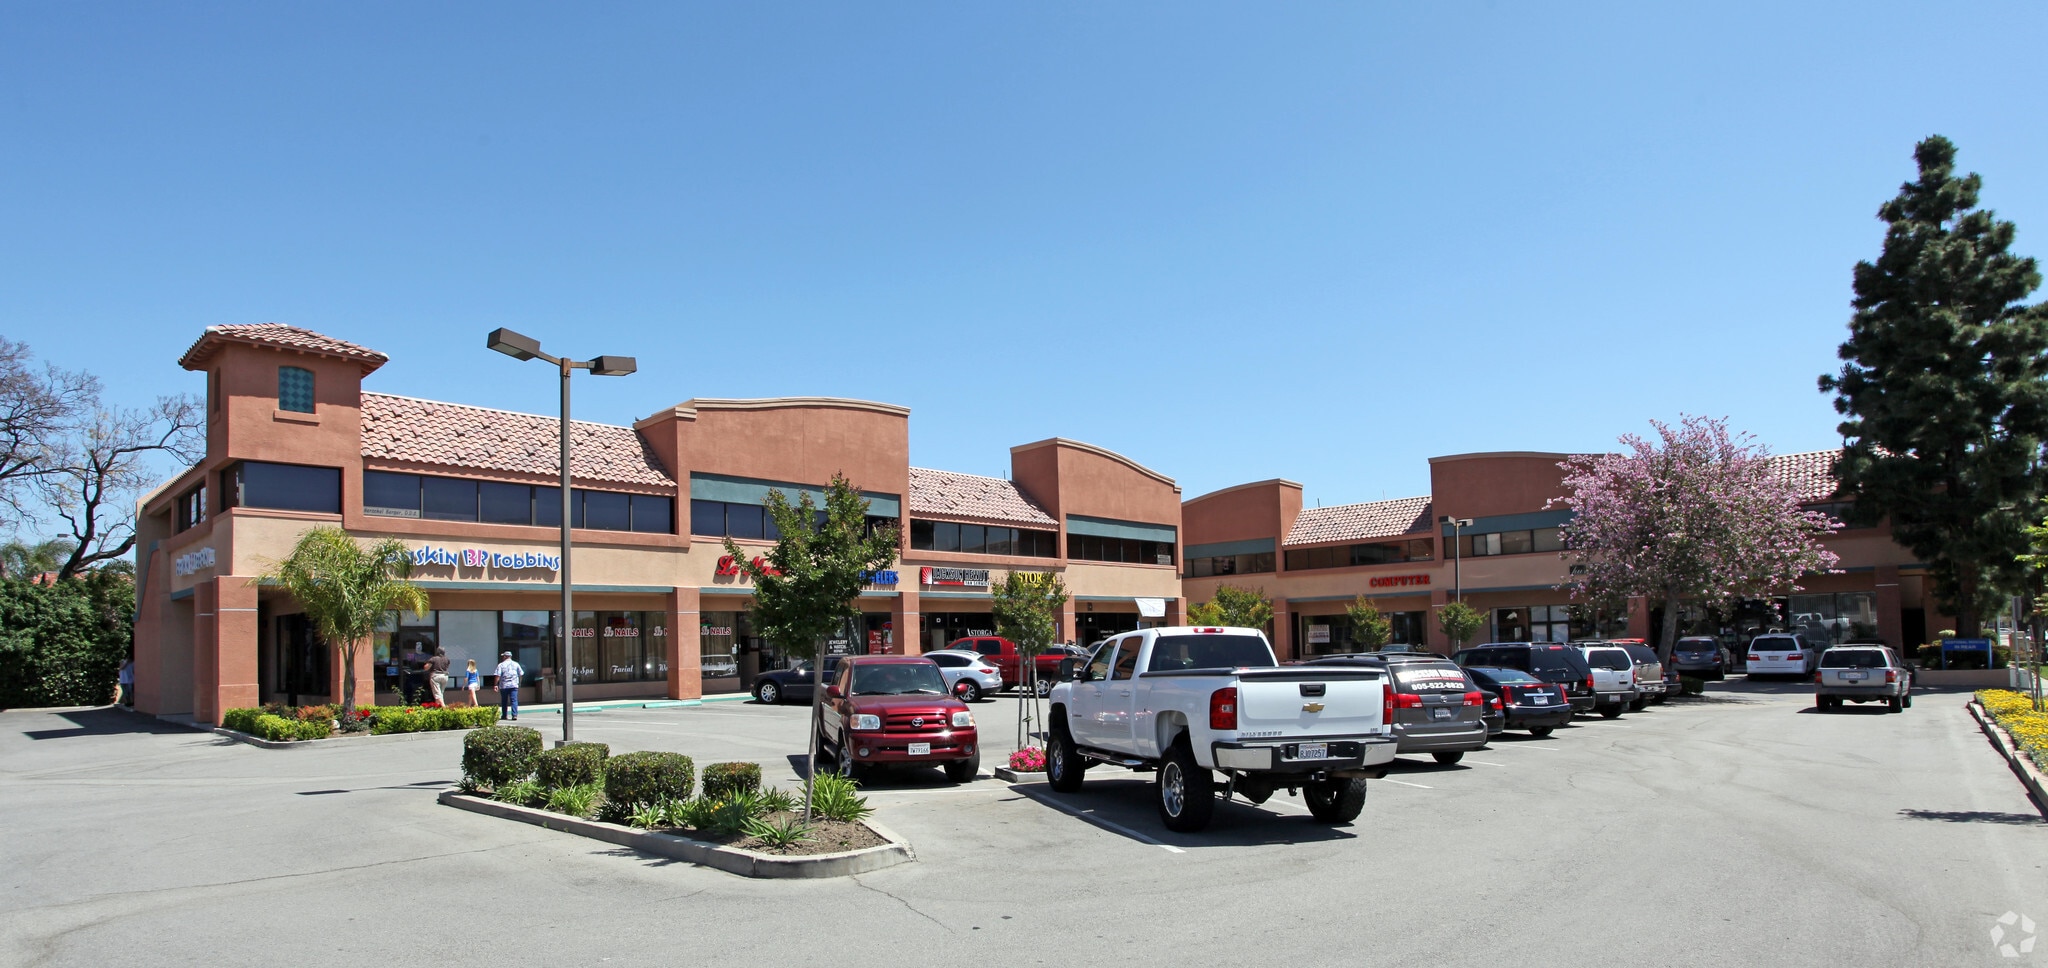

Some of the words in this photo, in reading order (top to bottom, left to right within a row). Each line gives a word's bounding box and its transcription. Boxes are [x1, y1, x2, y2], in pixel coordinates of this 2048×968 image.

[463, 549, 488, 567] BR
[493, 552, 560, 571] robbins
[715, 555, 740, 576] Le
[932, 567, 964, 580] JACKSON
[964, 569, 990, 581] HEWITT
[1369, 574, 1431, 588] COMPUTER
[615, 628, 639, 637] NAILS
[710, 627, 731, 635] NAILS
[967, 628, 993, 636] ASTORGA
[580, 667, 594, 675] Spa
[612, 665, 633, 674] Facial
